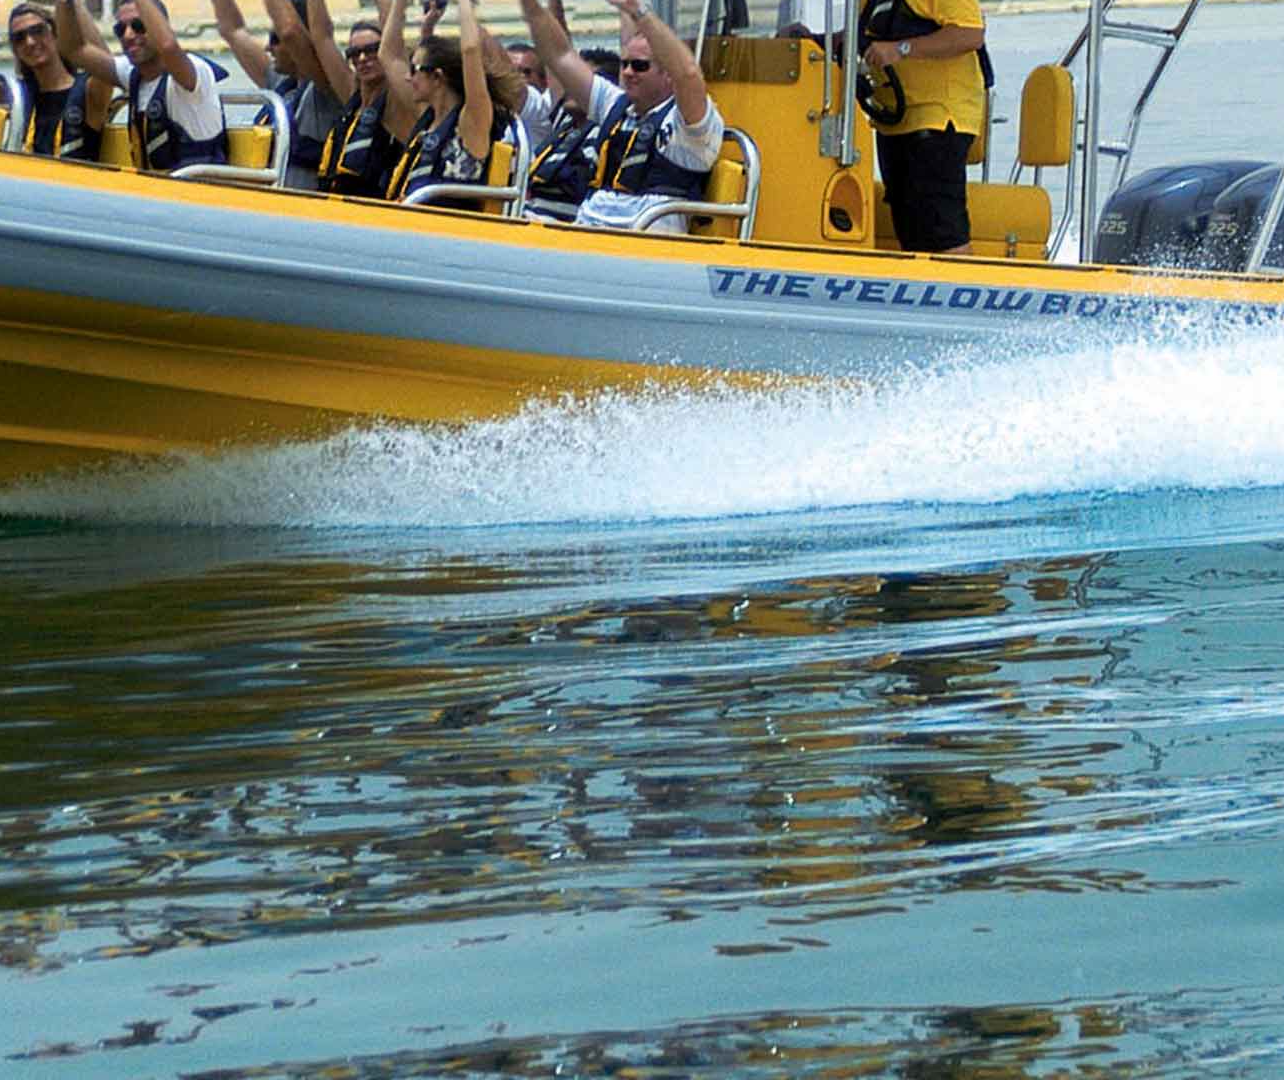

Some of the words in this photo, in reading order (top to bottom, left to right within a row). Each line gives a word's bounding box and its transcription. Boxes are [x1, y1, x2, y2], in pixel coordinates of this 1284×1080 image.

[1100, 221, 1127, 235] 225
[714, 269, 816, 298] THE
[823, 277, 1033, 311] YELLOW
